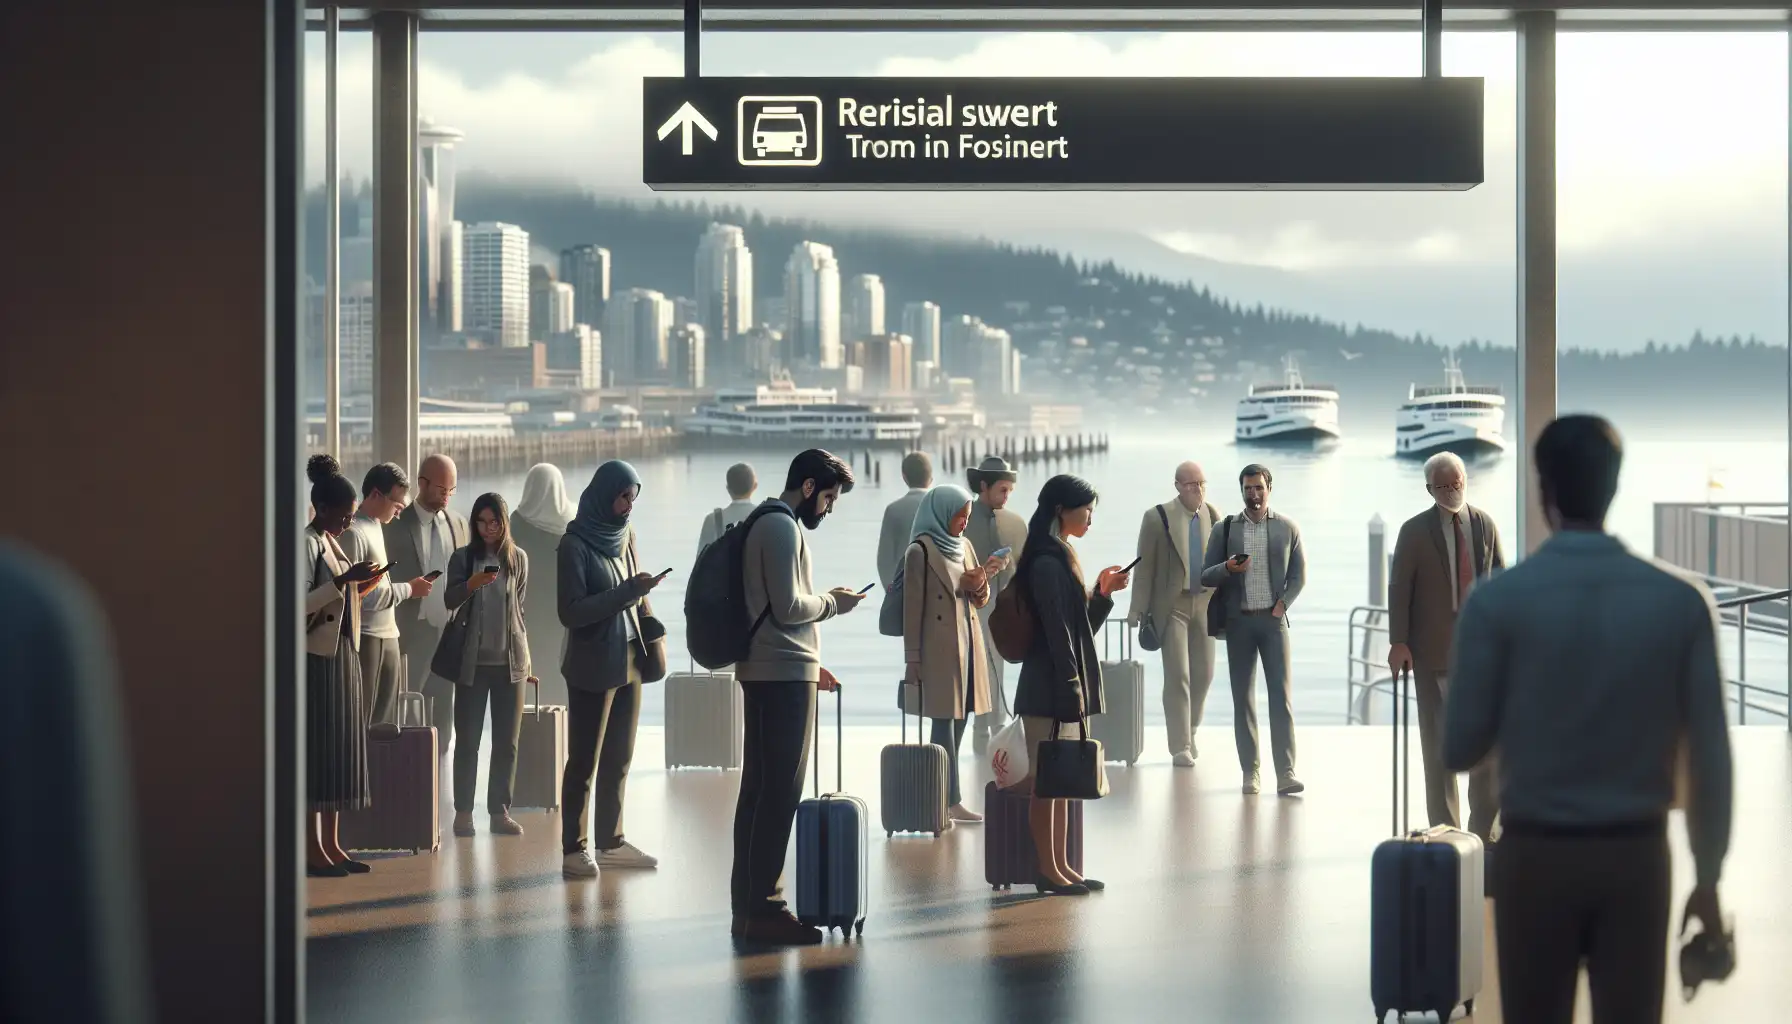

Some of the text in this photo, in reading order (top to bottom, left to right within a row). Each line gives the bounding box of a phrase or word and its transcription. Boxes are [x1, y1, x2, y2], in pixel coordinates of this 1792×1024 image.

[838, 94, 953, 127] Rerisial
[845, 133, 1069, 159] Trom in Fosinert
